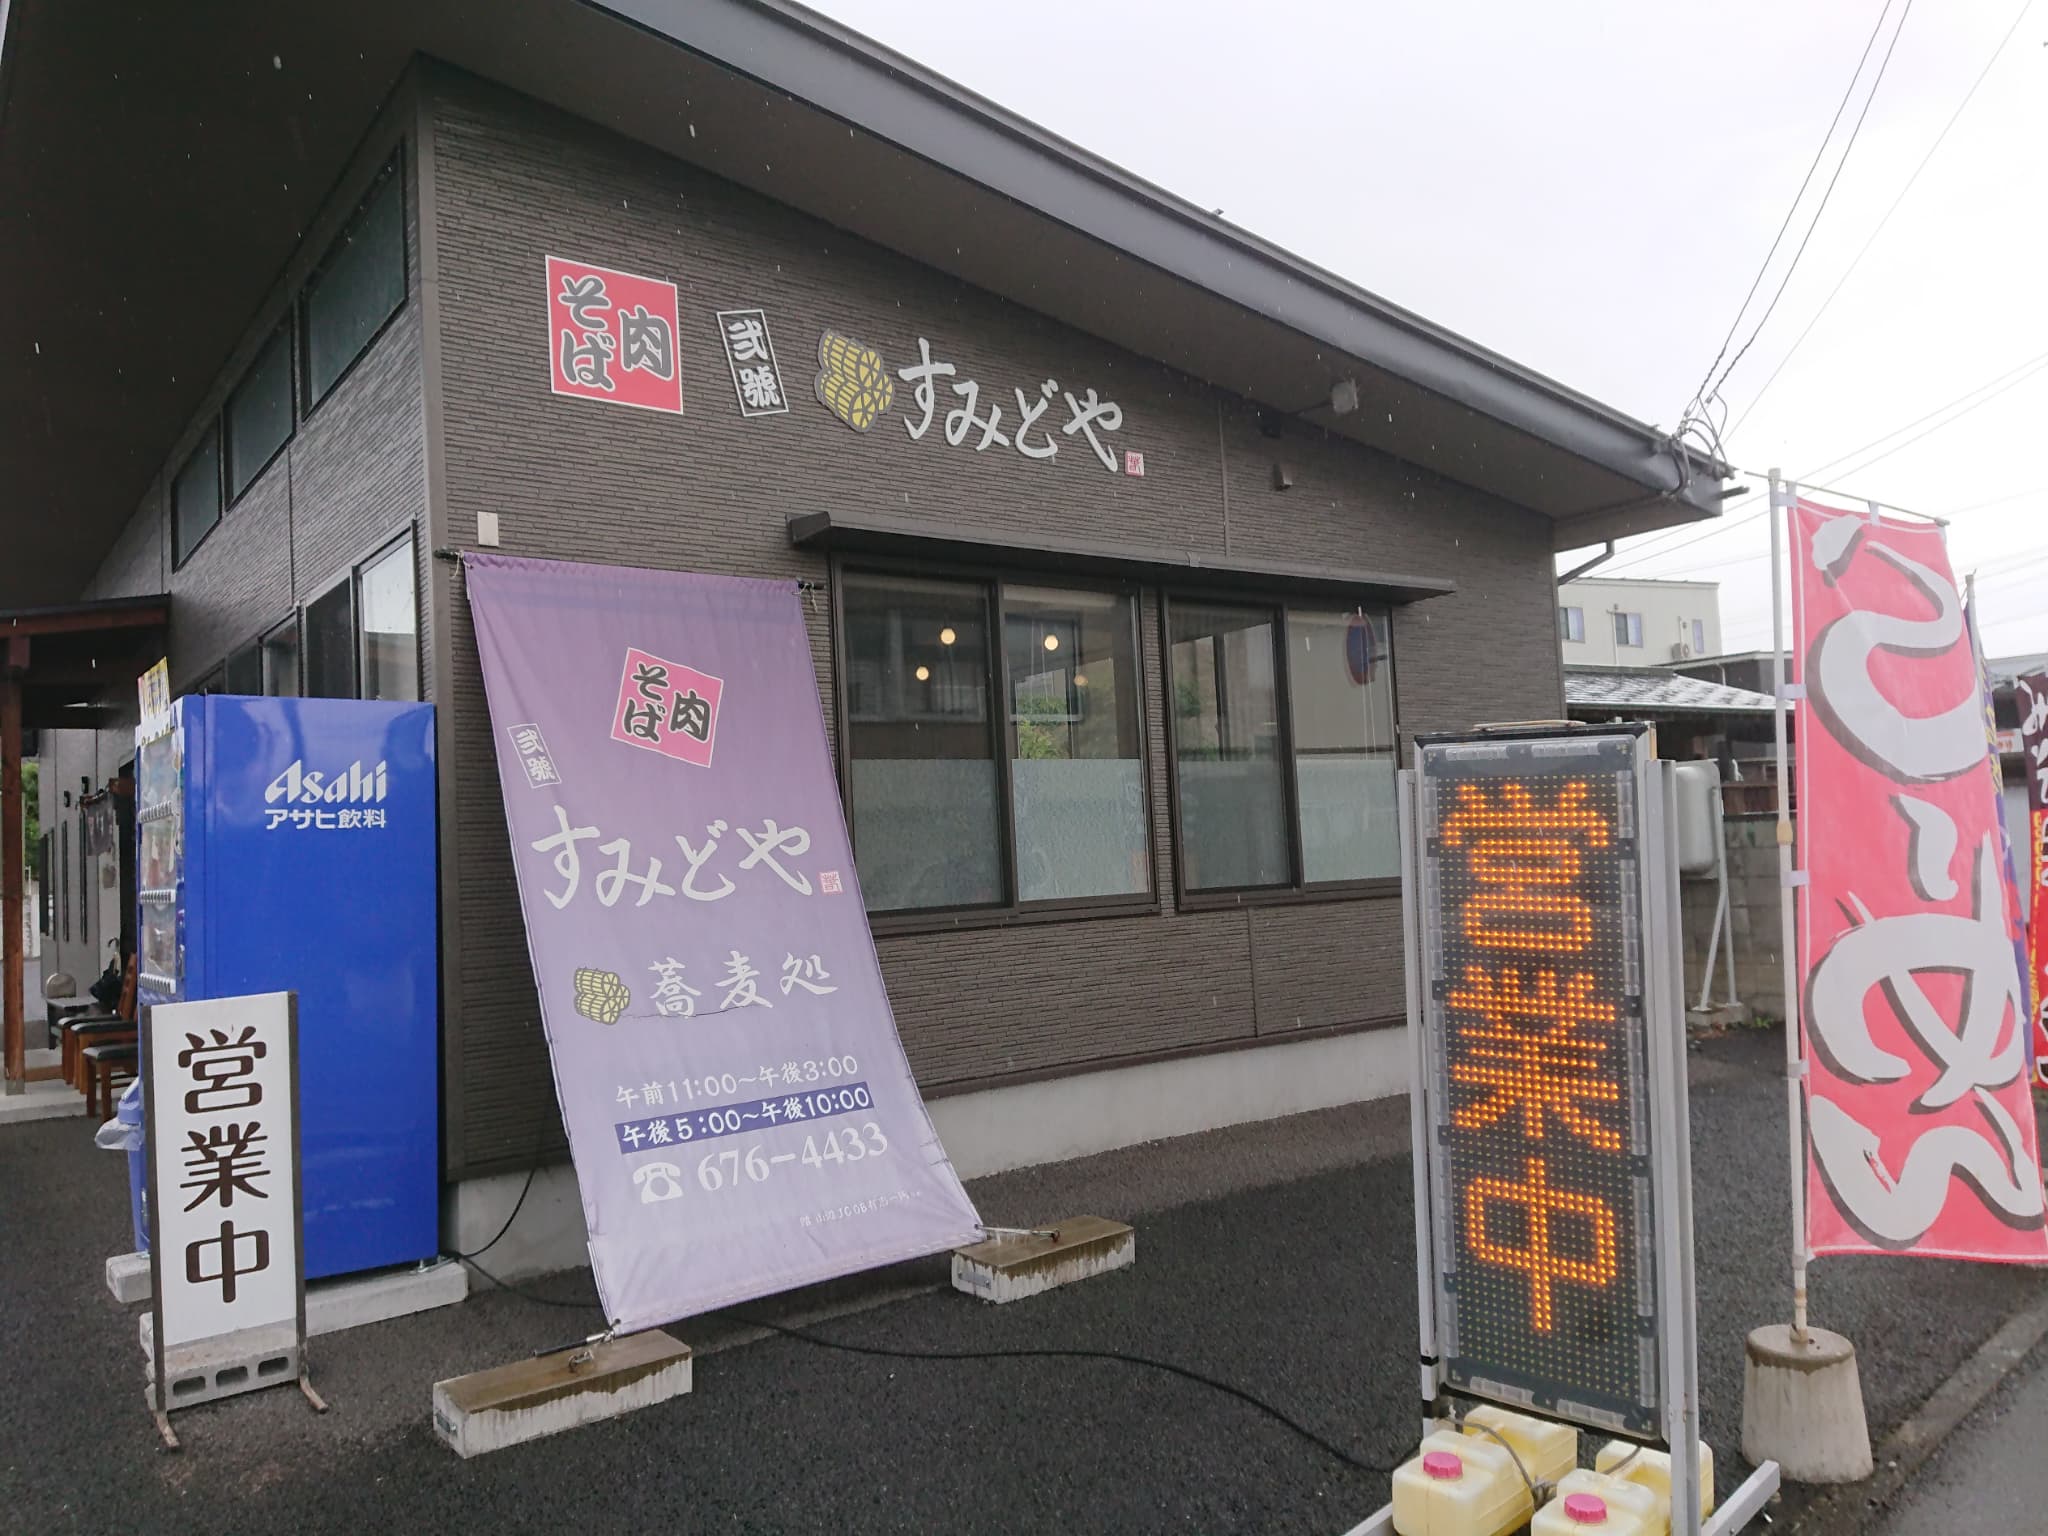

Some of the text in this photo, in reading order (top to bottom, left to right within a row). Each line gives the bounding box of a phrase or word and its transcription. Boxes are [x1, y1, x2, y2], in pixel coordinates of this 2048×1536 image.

[558, 275, 617, 392] そば
[618, 304, 674, 382] 肉
[898, 337, 1123, 473] すみどや
[621, 661, 670, 745] そば
[668, 688, 712, 743] 肉
[264, 759, 388, 804] Asahi
[265, 808, 387, 830] アサヒ飲料
[531, 805, 812, 910] すみどや
[648, 950, 839, 1020] 蕎麦処
[1444, 781, 1621, 1332] 営業中
[178, 1026, 271, 1304] 営業中
